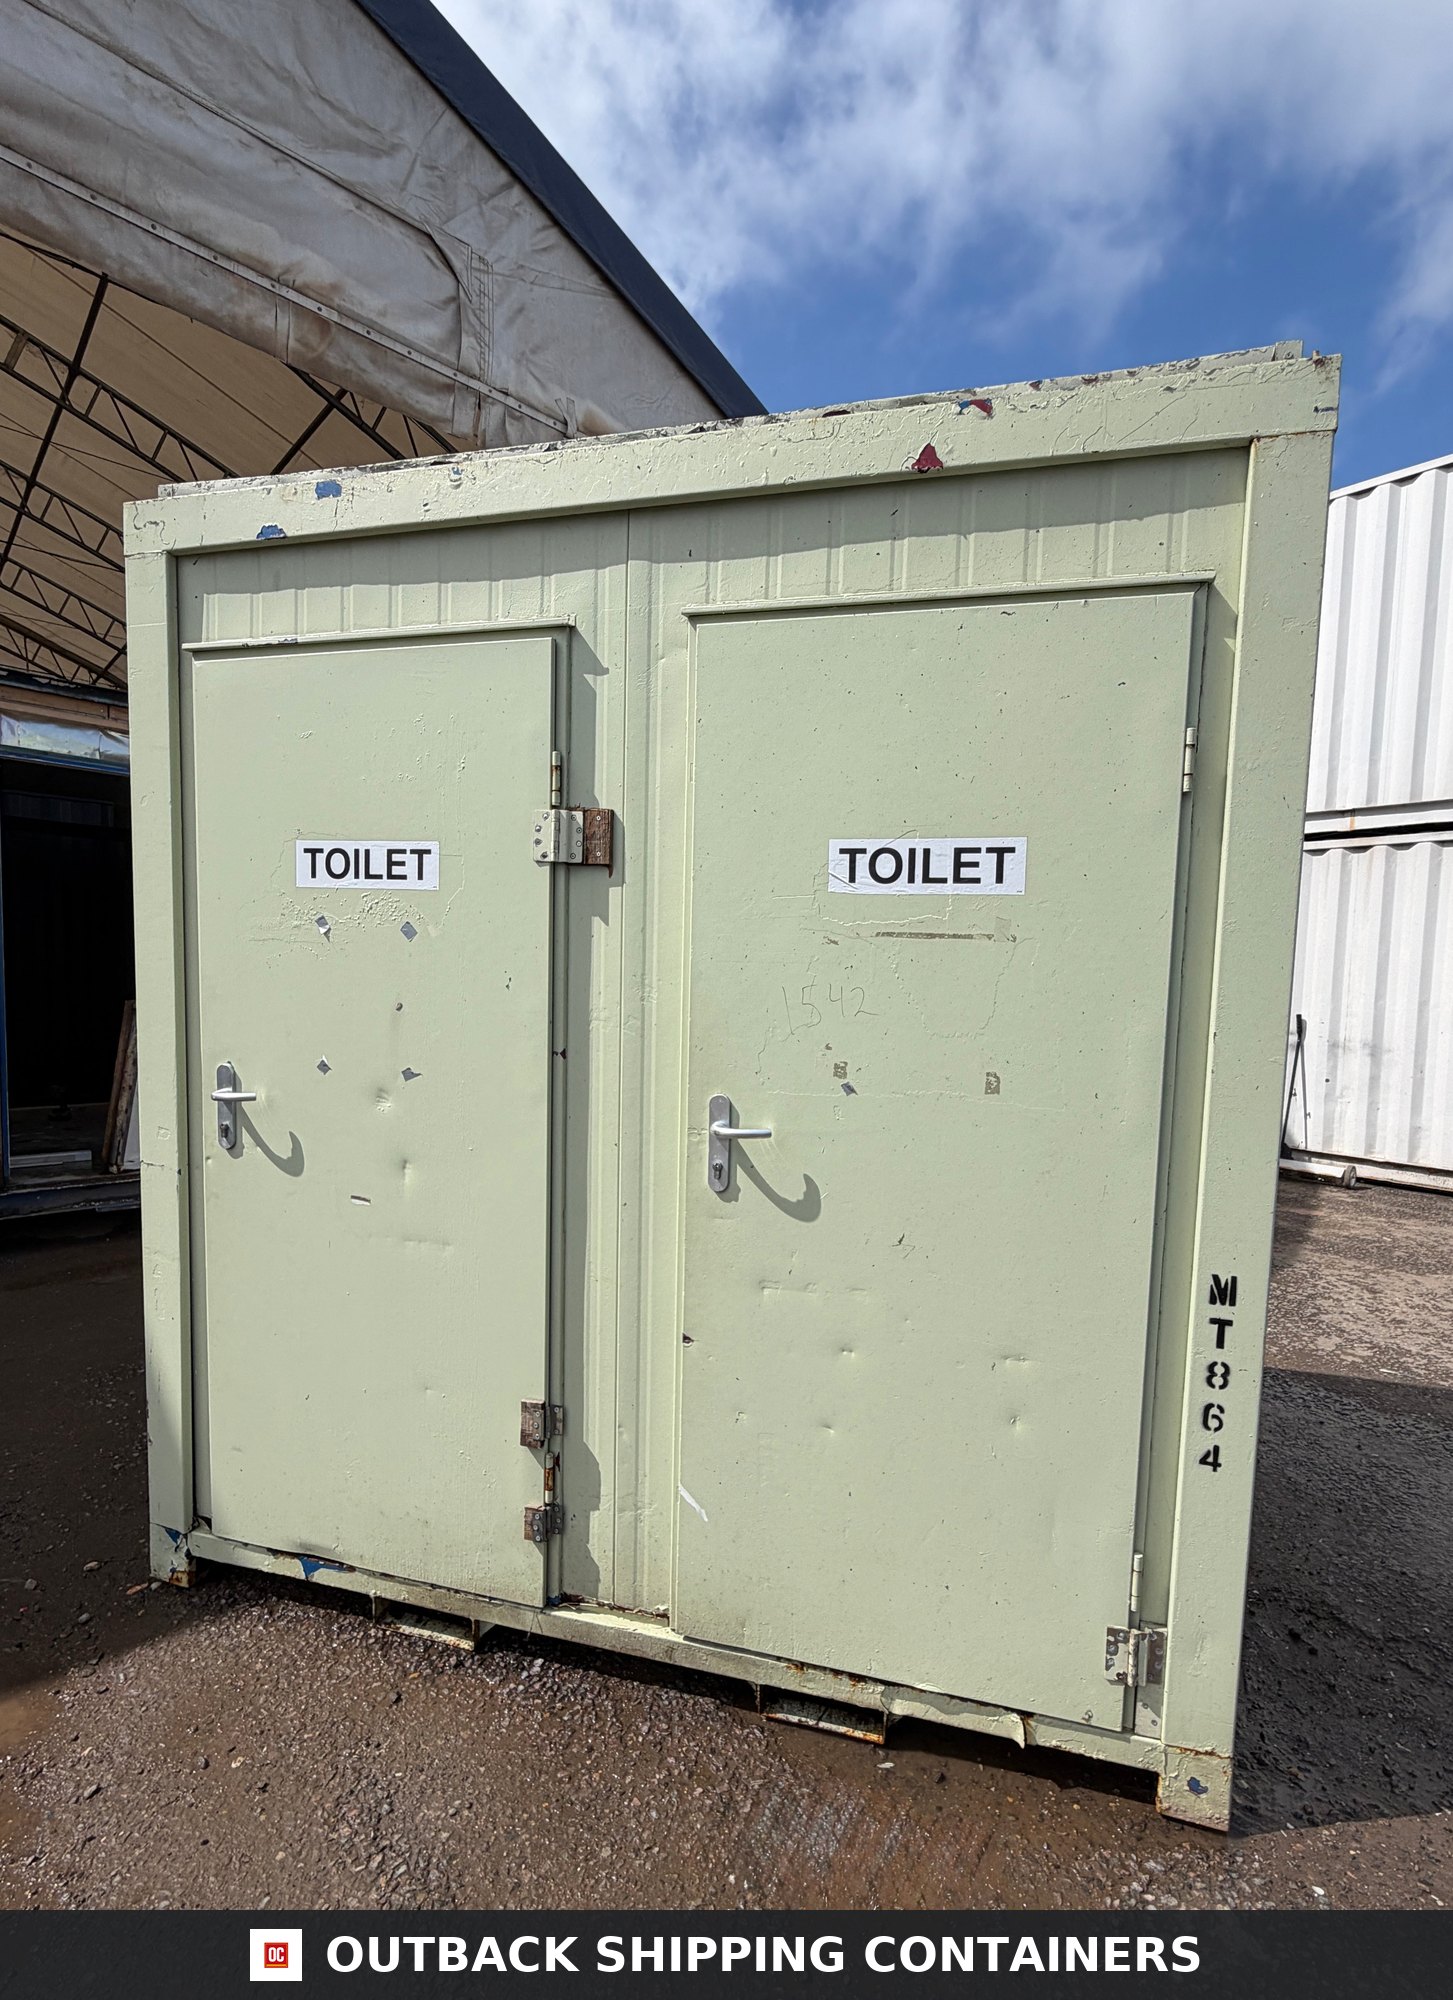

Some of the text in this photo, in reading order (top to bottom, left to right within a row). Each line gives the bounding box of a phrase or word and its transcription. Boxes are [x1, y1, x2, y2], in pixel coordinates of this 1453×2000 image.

[303, 847, 432, 881] TOILET
[838, 846, 1016, 885] TOILET
[781, 982, 880, 1036] 1542
[1198, 1273, 1238, 1473] MT864
